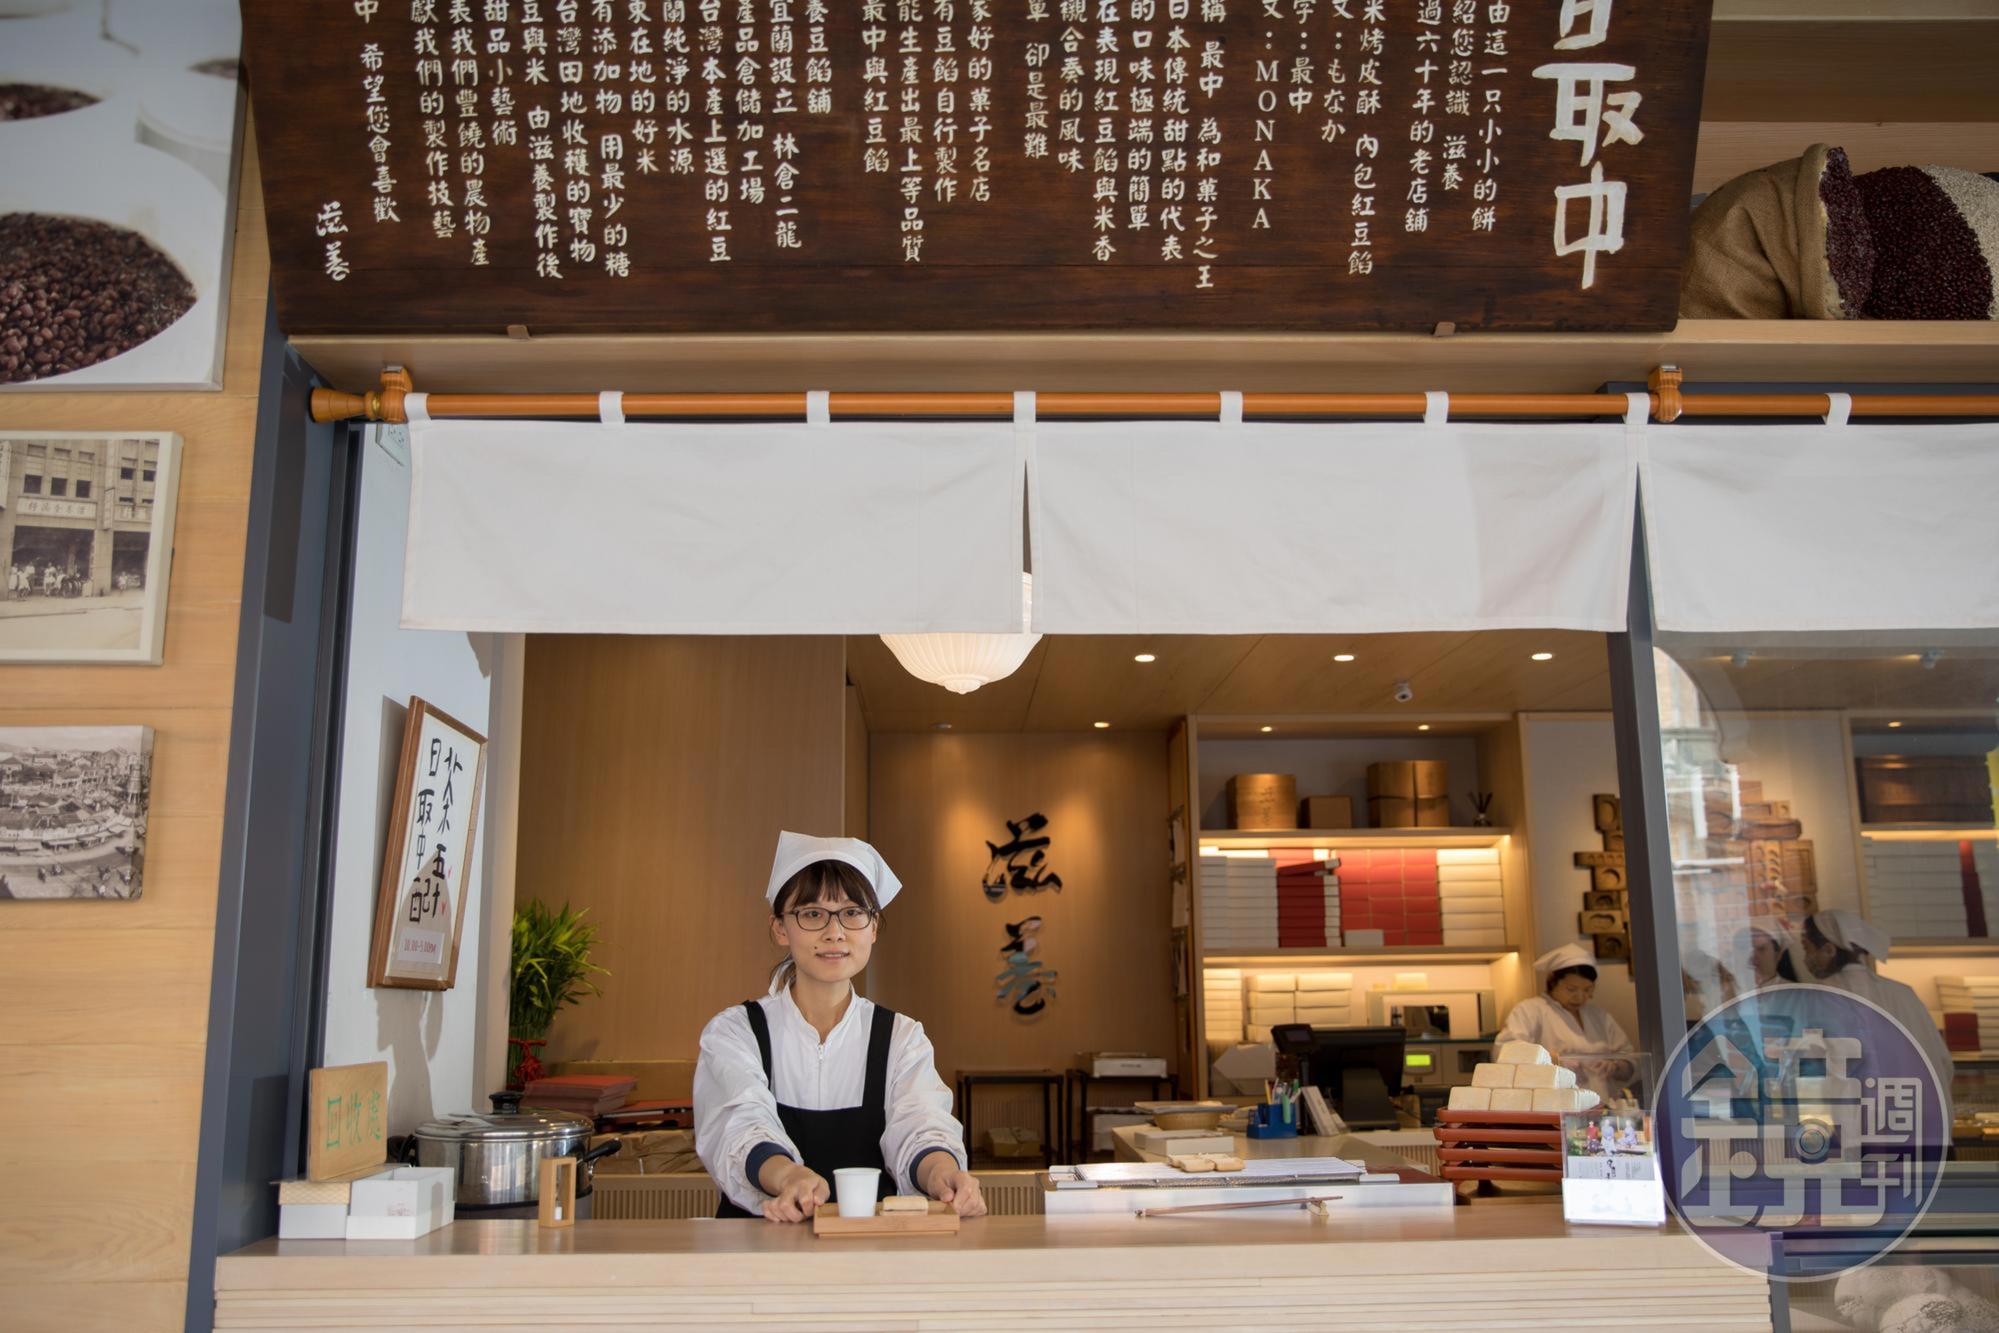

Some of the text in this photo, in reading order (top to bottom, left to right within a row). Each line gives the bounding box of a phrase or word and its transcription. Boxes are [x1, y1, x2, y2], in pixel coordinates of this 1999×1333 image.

[354, 0, 401, 223] 中 希望您會喜歡
[483, 0, 518, 146] 甜品小藝術
[521, 0, 563, 279] 豆與米 由滋養製作後
[555, 0, 596, 263] 台灣田地收穫的寶物
[628, 0, 659, 175] 東在地的好米
[698, 0, 733, 262] 台灣本產上選的紅豆
[735, 0, 766, 205] 產品倉儲加工場
[861, 0, 890, 173] 最中與紅豆餡
[896, 0, 925, 262] 能生產出最上等品質
[932, 0, 959, 203] 有豆餡自行製作
[967, 0, 995, 202] 家好的菓子名店
[1024, 42, 1050, 160] 卻是最難
[1091, 0, 1121, 262] 在表現紅豆餡與米香
[1127, 0, 1156, 231] 的口味極端的簡單
[1159, 0, 1191, 262] 日本傳統甜點的代表
[1198, 40, 1225, 99] 最中
[1441, 0, 1477, 191] 紹您認識 滋養
[1471, 0, 1511, 232] 由這一只小小的餅
[600, 133, 631, 278] 用最少的糖
[772, 132, 802, 249] 林倉二龍
[1192, 116, 1222, 289] 為和菓子之王
